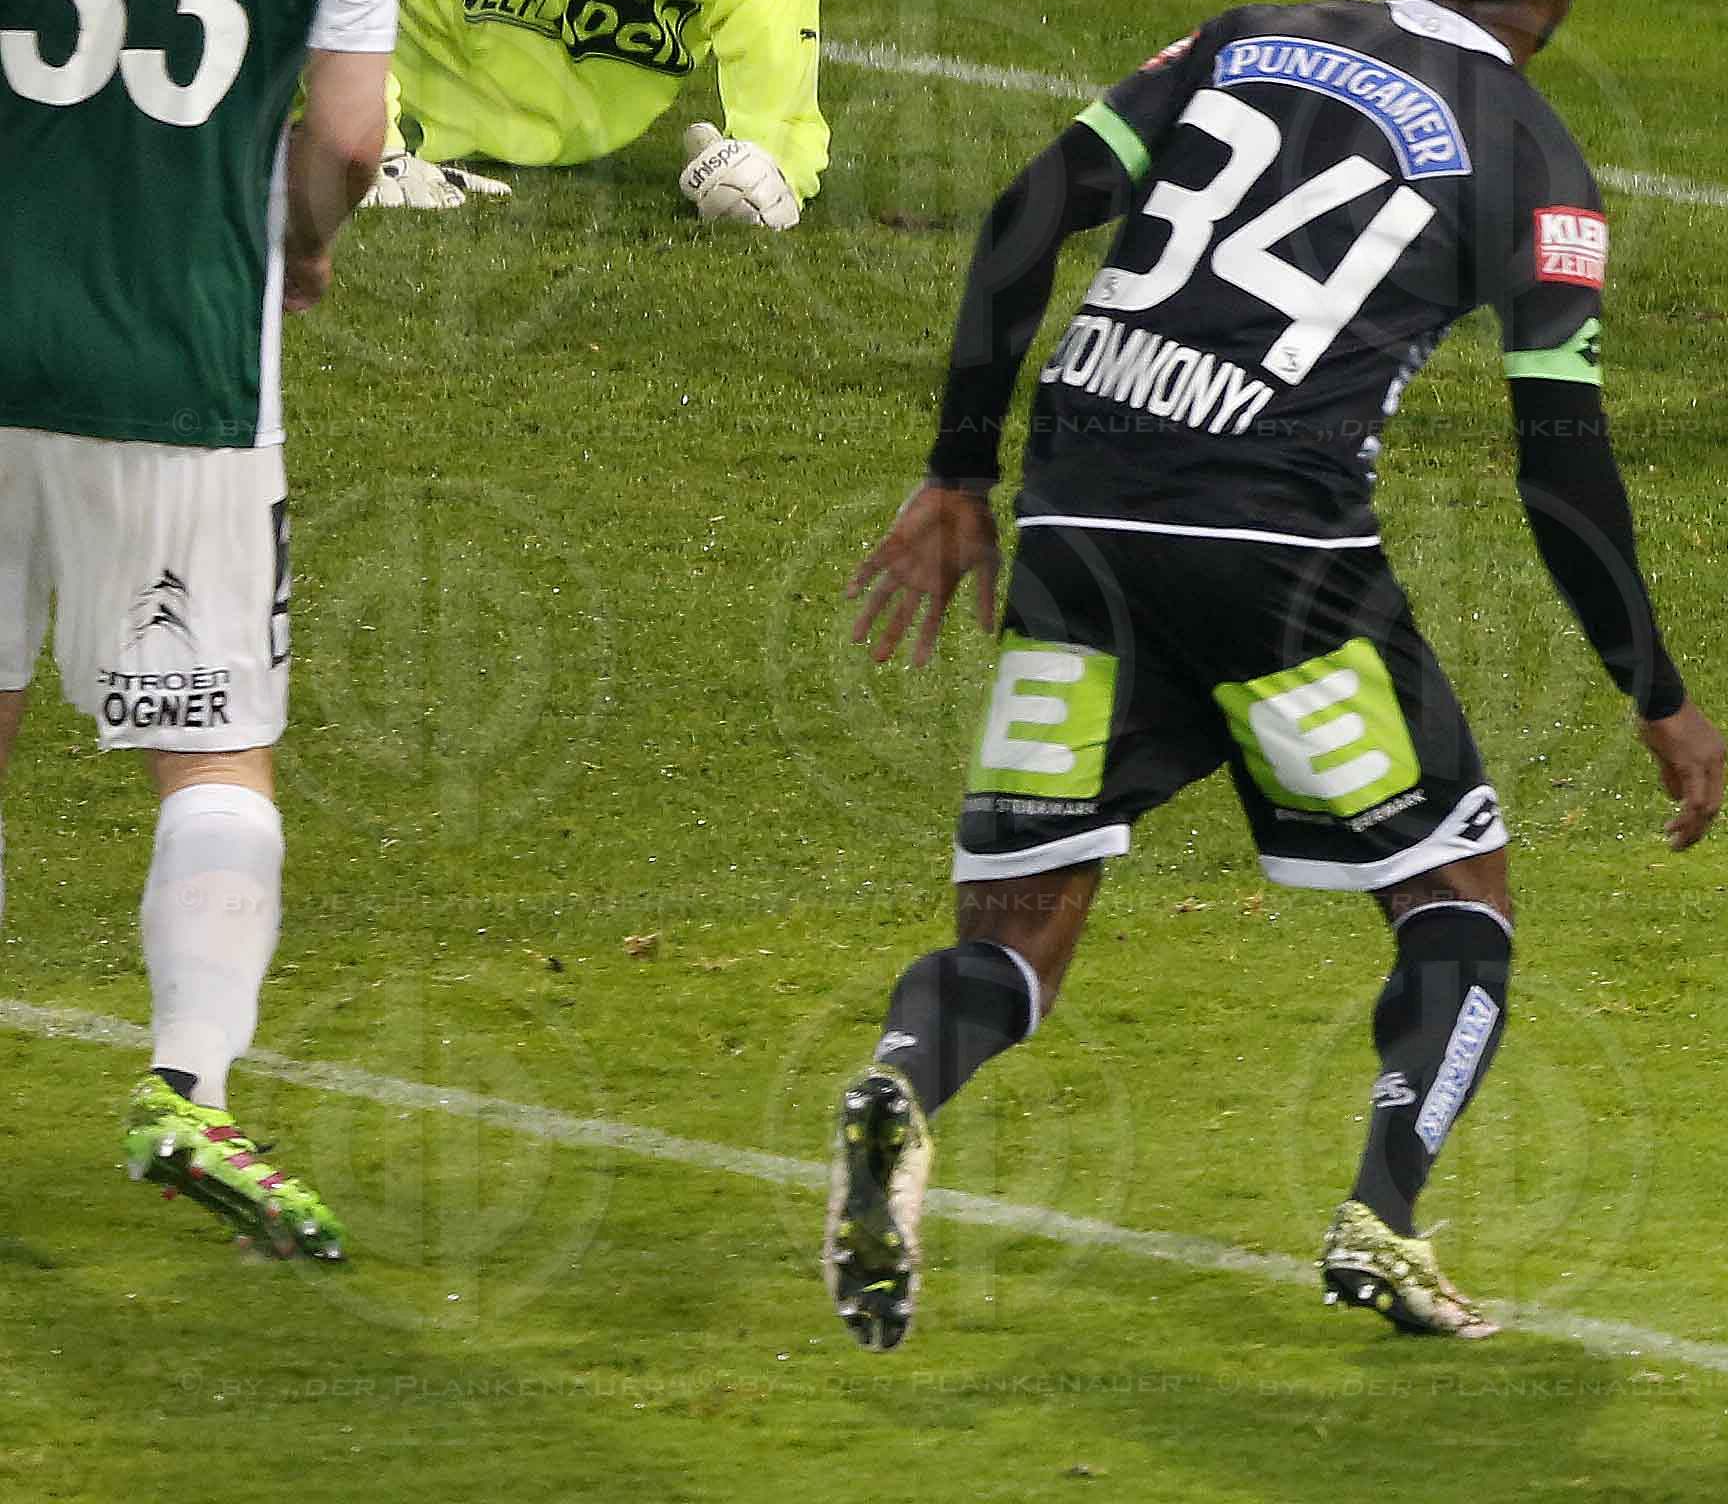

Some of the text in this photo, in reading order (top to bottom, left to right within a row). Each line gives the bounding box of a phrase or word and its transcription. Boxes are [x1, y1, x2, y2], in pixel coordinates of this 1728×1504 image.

[1230, 42, 1460, 168] PUNTIGAMER
[1084, 87, 1437, 387] 34
[1540, 213, 1608, 246] KLEI
[102, 690, 232, 728] OGNER
